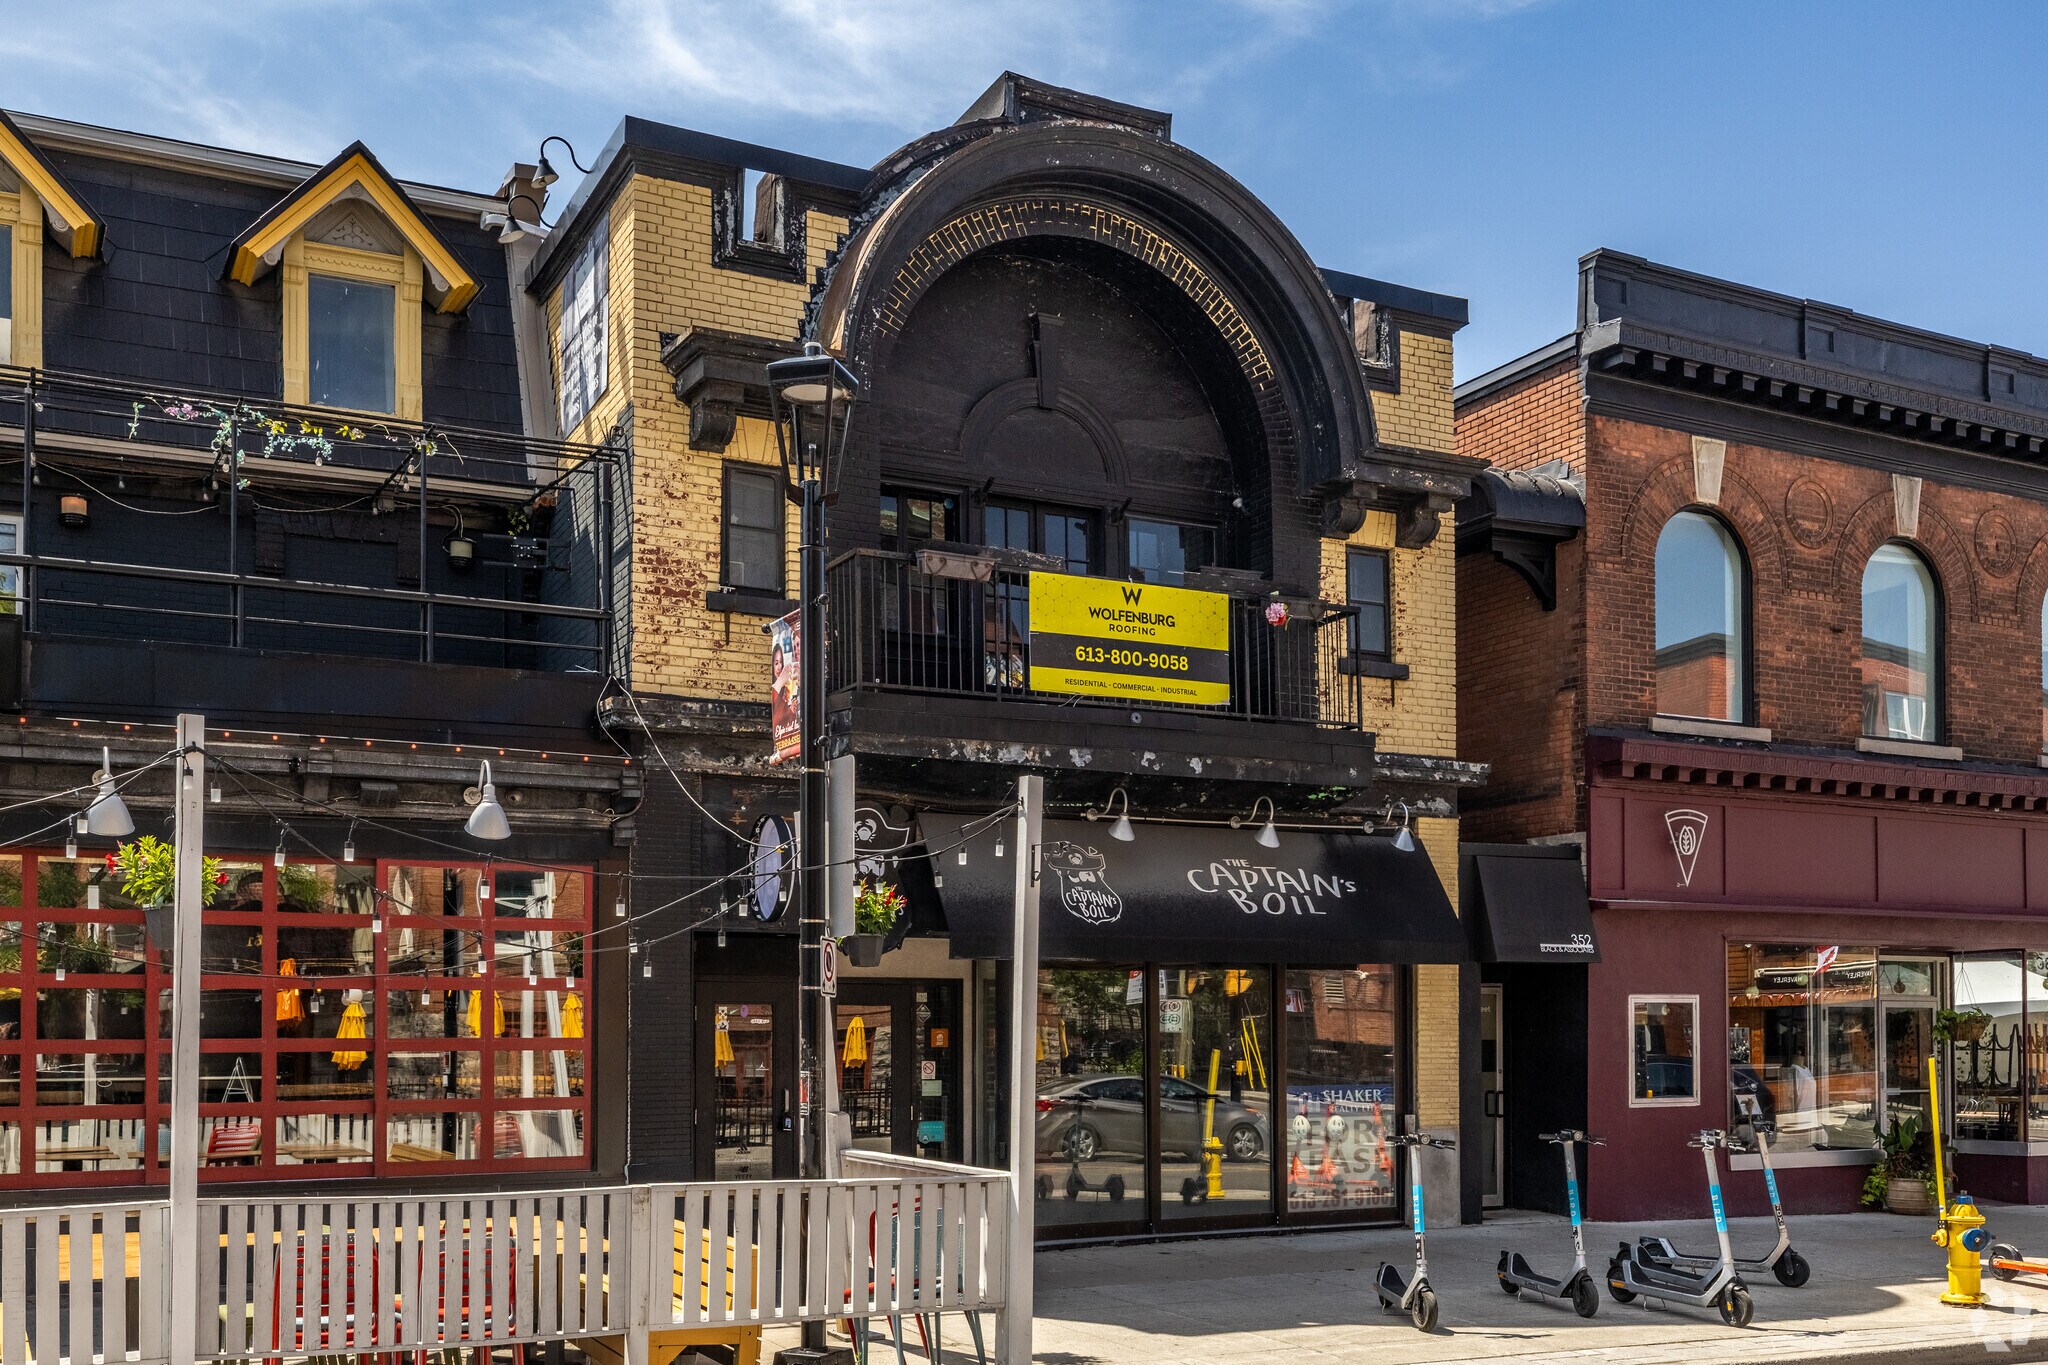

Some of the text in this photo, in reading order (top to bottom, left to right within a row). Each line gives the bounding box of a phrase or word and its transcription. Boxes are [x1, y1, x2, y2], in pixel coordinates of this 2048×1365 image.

[1088, 606, 1176, 628] WOLFENBURG
[1108, 623, 1156, 636] ROOFING
[1075, 646, 1189, 671] 613-800-9058
[1064, 678, 1198, 697] RESIDENTIAL COMMERCIAL INDUSTRIAL
[1222, 858, 1250, 867] THE
[1078, 902, 1110, 918] BOIL
[1227, 888, 1327, 915] BOIL
[1570, 933, 1592, 946] 352
[1323, 1088, 1382, 1102] SHAKER
[1766, 1175, 1775, 1198] BIRD
[1412, 1195, 1420, 1224] BIRD
[1568, 1189, 1576, 1217] BIRD
[1711, 1194, 1722, 1223] BIRD
